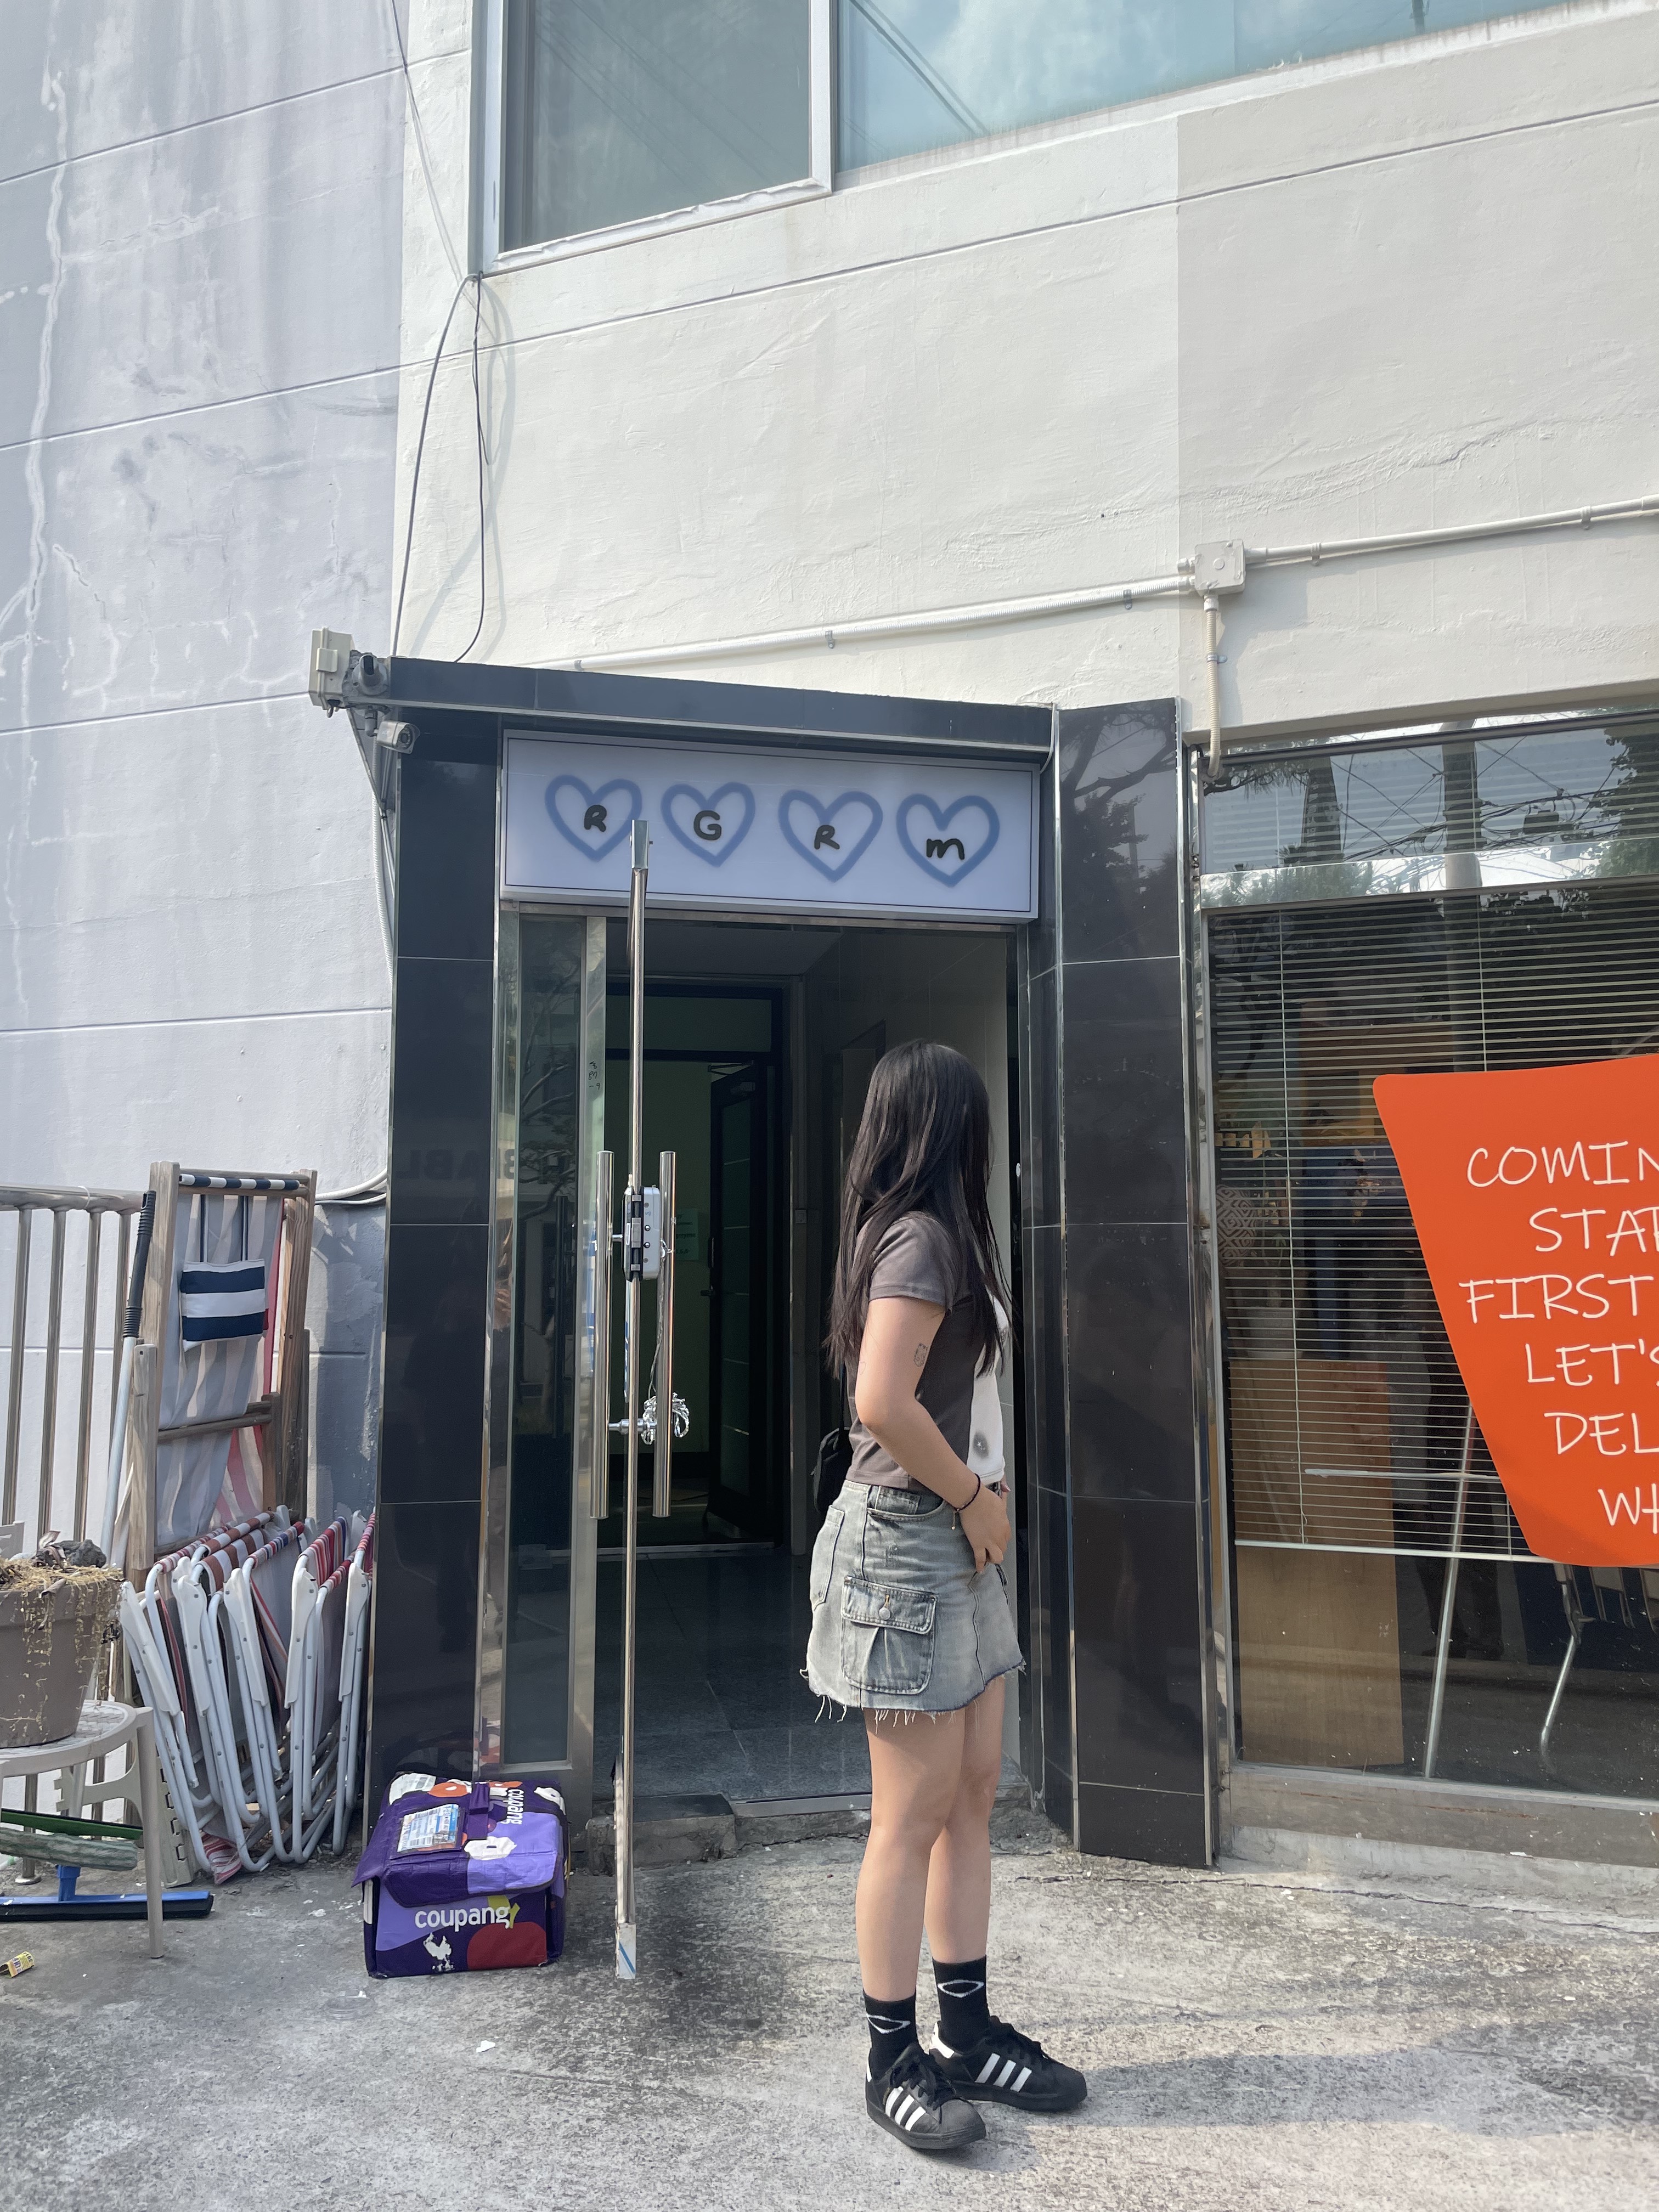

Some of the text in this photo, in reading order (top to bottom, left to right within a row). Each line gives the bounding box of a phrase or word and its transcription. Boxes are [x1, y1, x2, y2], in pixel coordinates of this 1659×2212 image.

[583, 804, 607, 832] R
[693, 810, 723, 841] G
[814, 824, 840, 850] R
[1466, 1141, 1659, 1187] COMIN
[1458, 1273, 1654, 1324] FIRST
[1543, 1412, 1659, 1455] DEL
[500, 1788, 524, 1825] coupang
[415, 1906, 510, 1933] coupang
